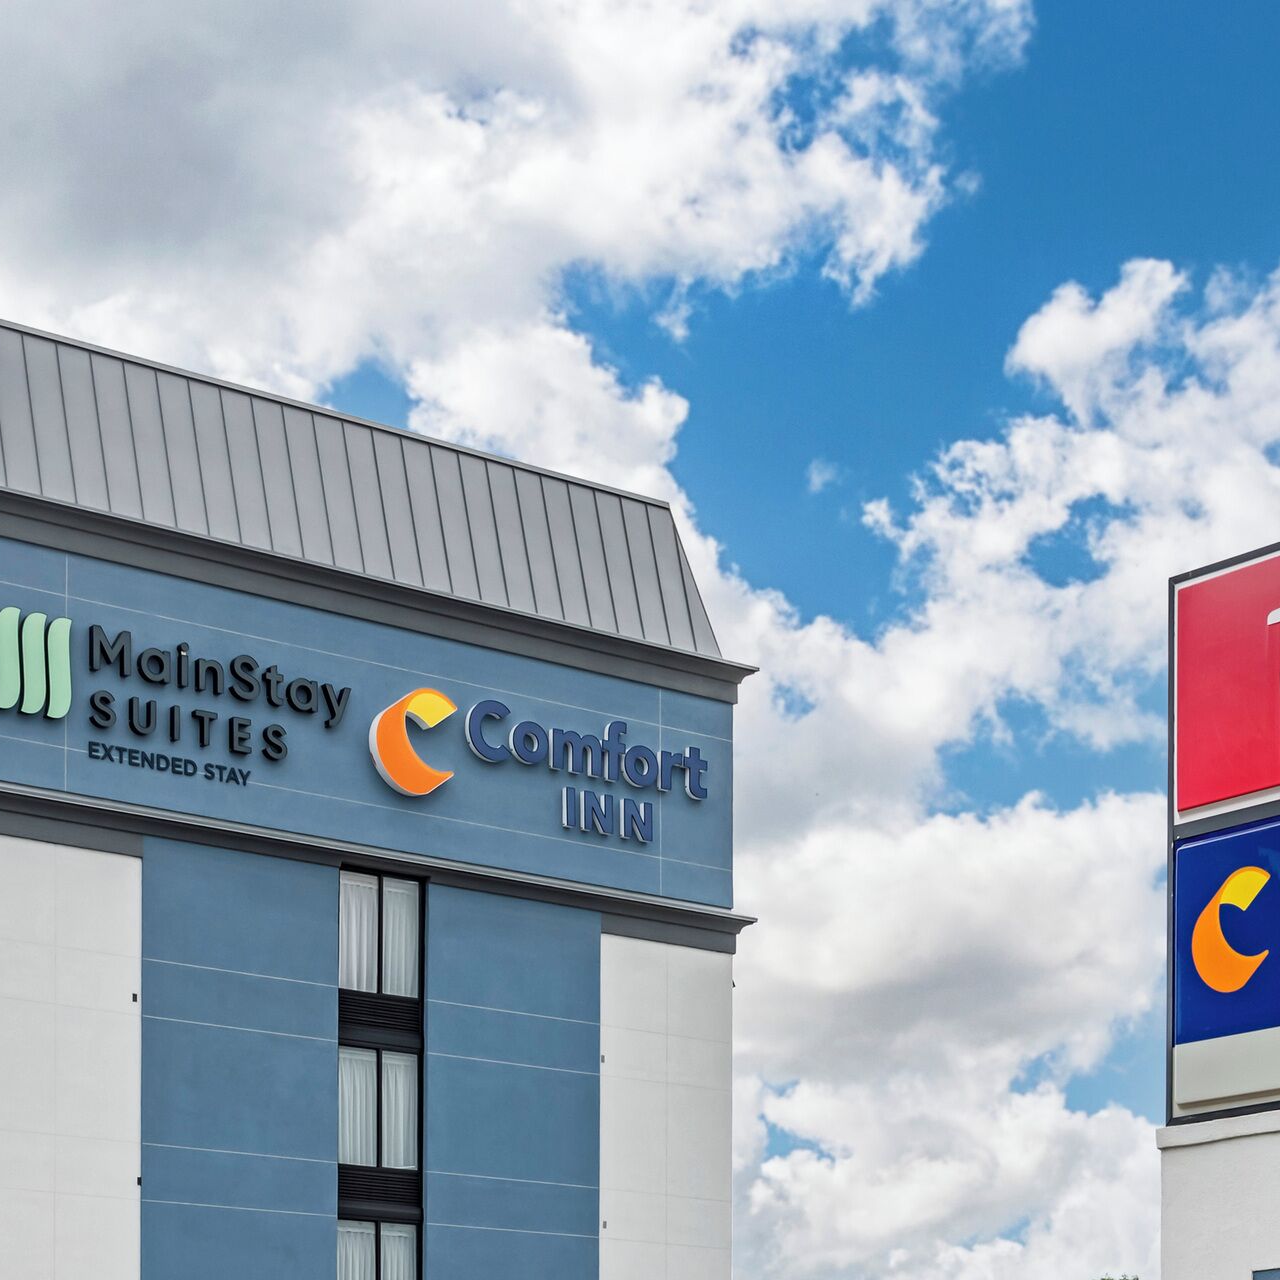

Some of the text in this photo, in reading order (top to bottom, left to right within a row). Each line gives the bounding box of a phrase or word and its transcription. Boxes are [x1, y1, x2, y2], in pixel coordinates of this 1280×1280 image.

[89, 625, 351, 728] MainStay
[89, 691, 288, 760] SUITES
[465, 700, 708, 800] Comfort
[88, 742, 251, 786] EXTENDED STAY
[562, 787, 653, 842] INN
